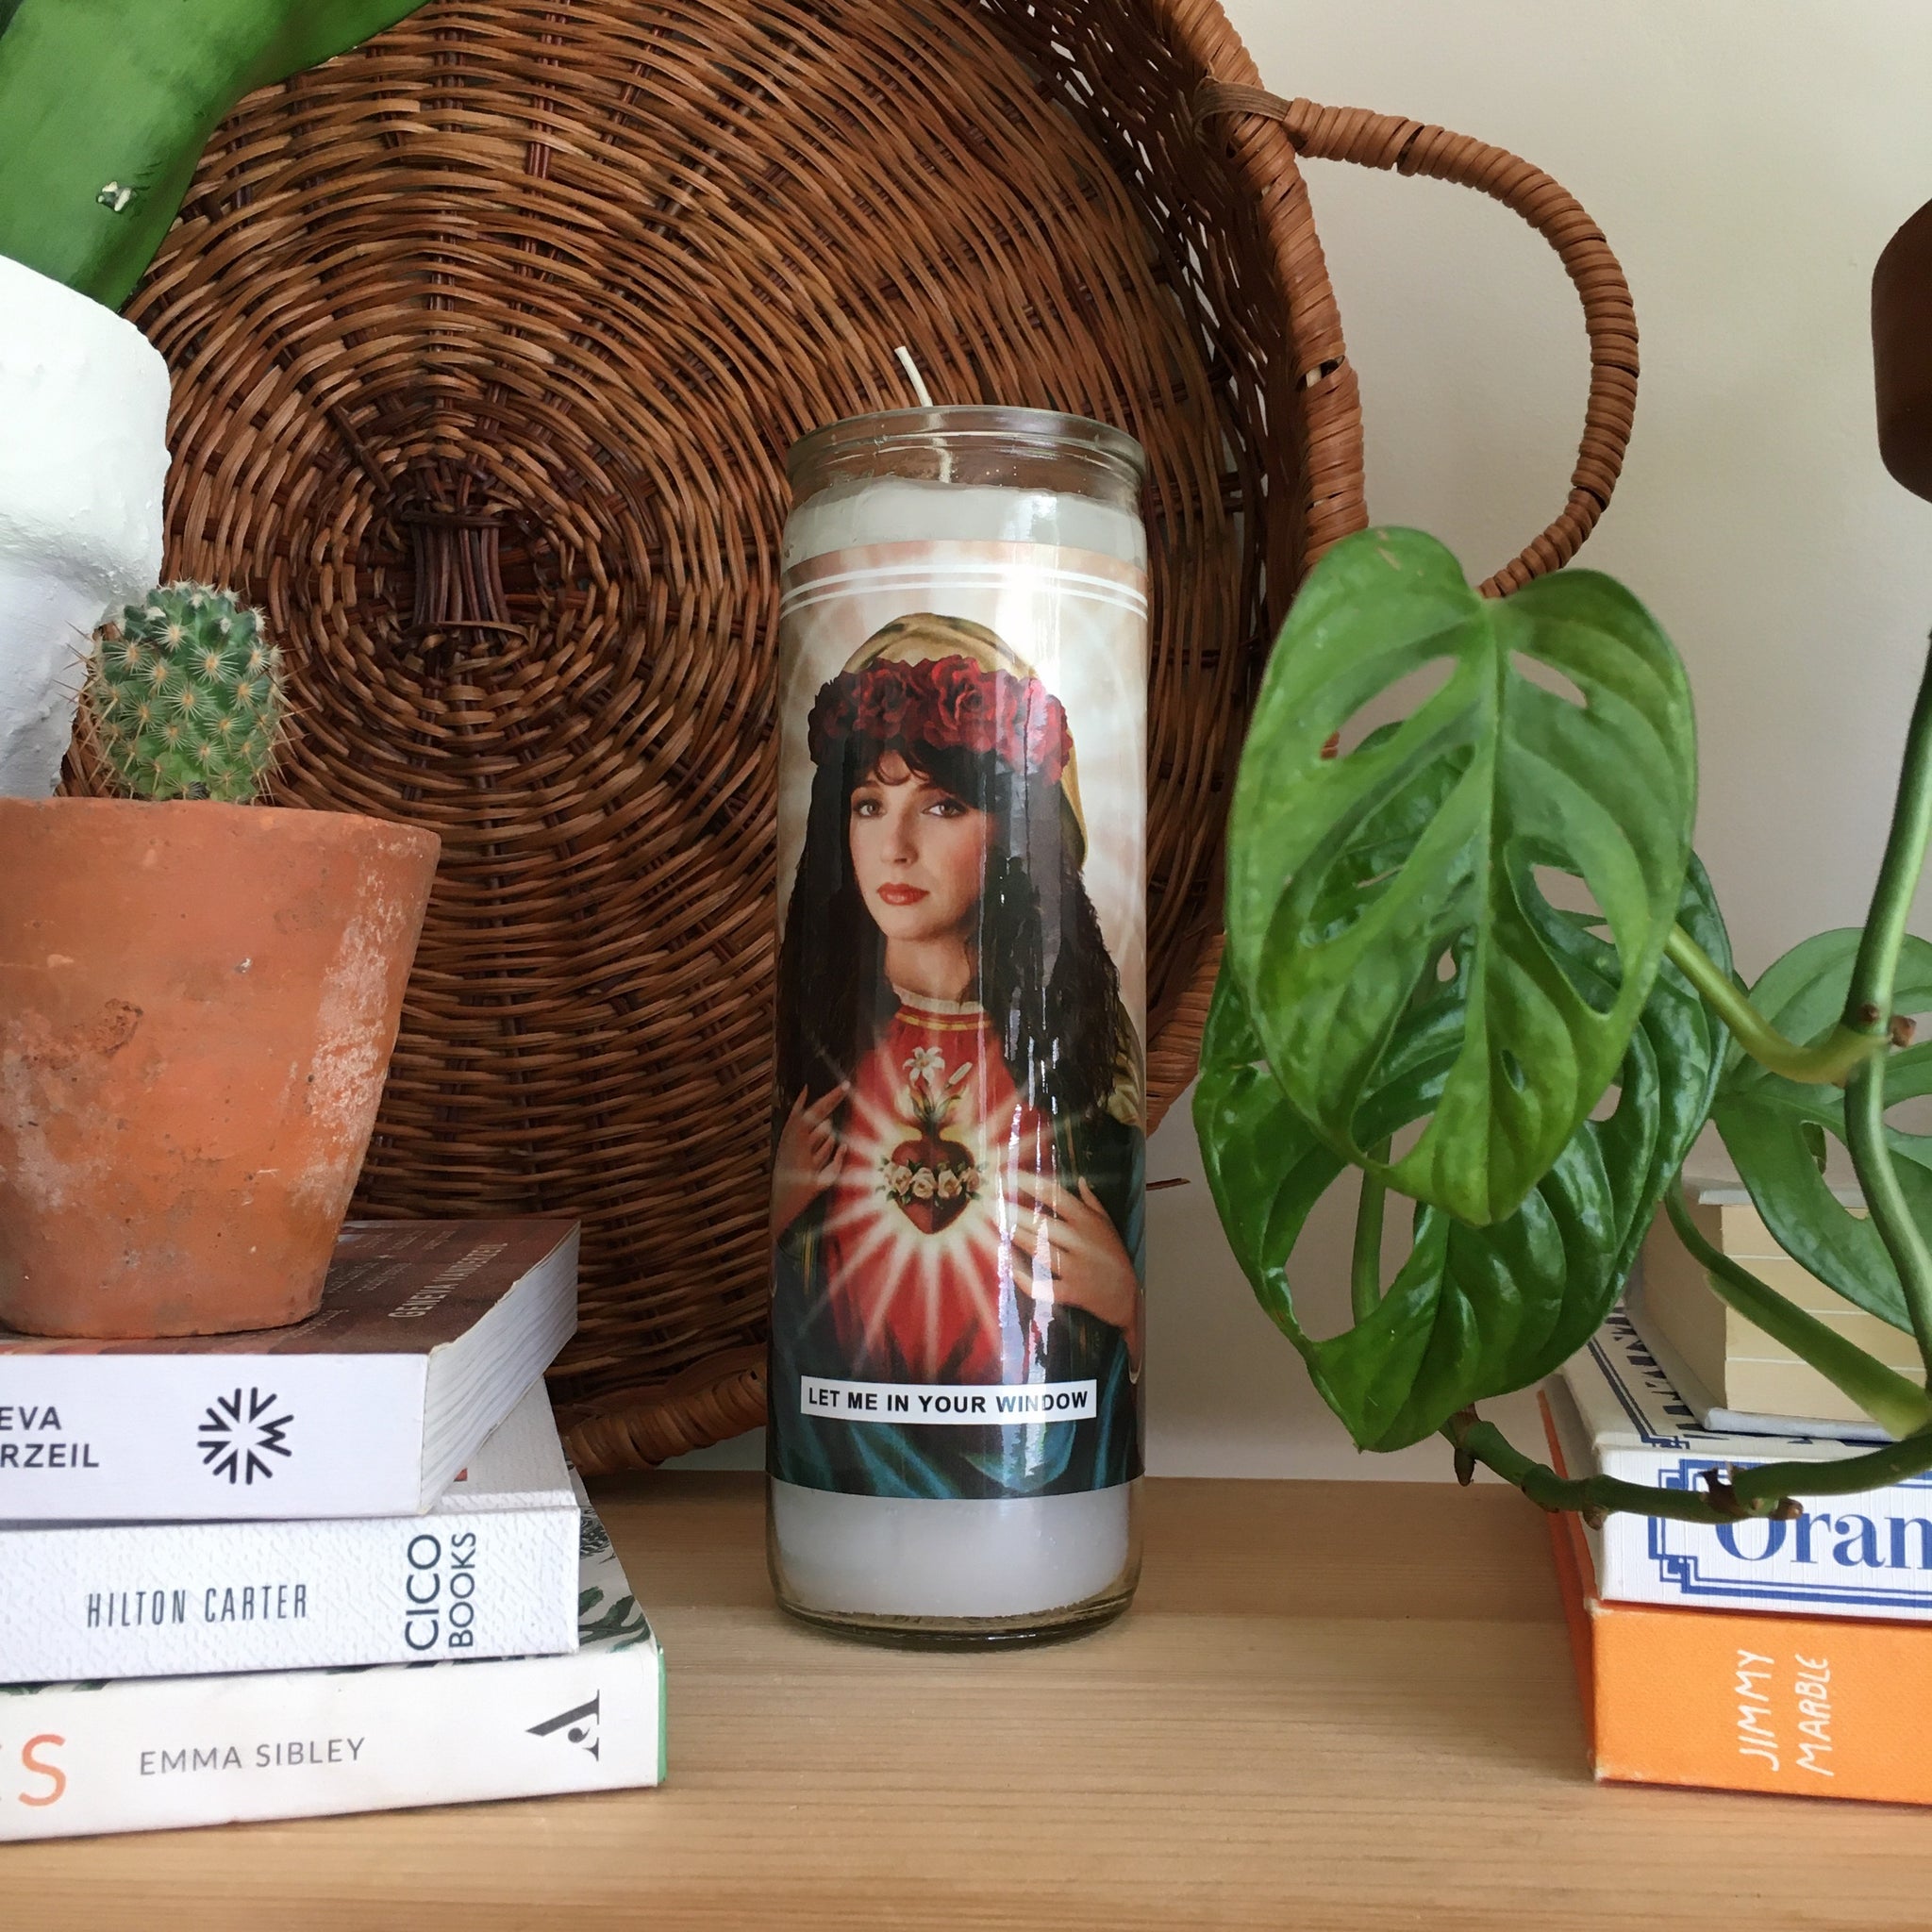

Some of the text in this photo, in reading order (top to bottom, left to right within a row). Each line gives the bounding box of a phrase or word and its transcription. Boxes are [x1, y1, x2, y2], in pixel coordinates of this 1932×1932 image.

[387, 1283, 459, 1318] GENEVA
[0, 1406, 62, 1431] EVA
[808, 1387, 1088, 1413] LET ME IN YOUR WINDOW
[0, 1442, 100, 1468] RZEIL
[87, 1584, 308, 1628] HILTON CARTER
[405, 1534, 441, 1651] CICO
[448, 1532, 477, 1648] BOOKS
[1734, 1649, 1781, 1773] JIMMY
[1794, 1653, 1835, 1777] MARBLE
[140, 1737, 366, 1776] EMMA SIBLEY
